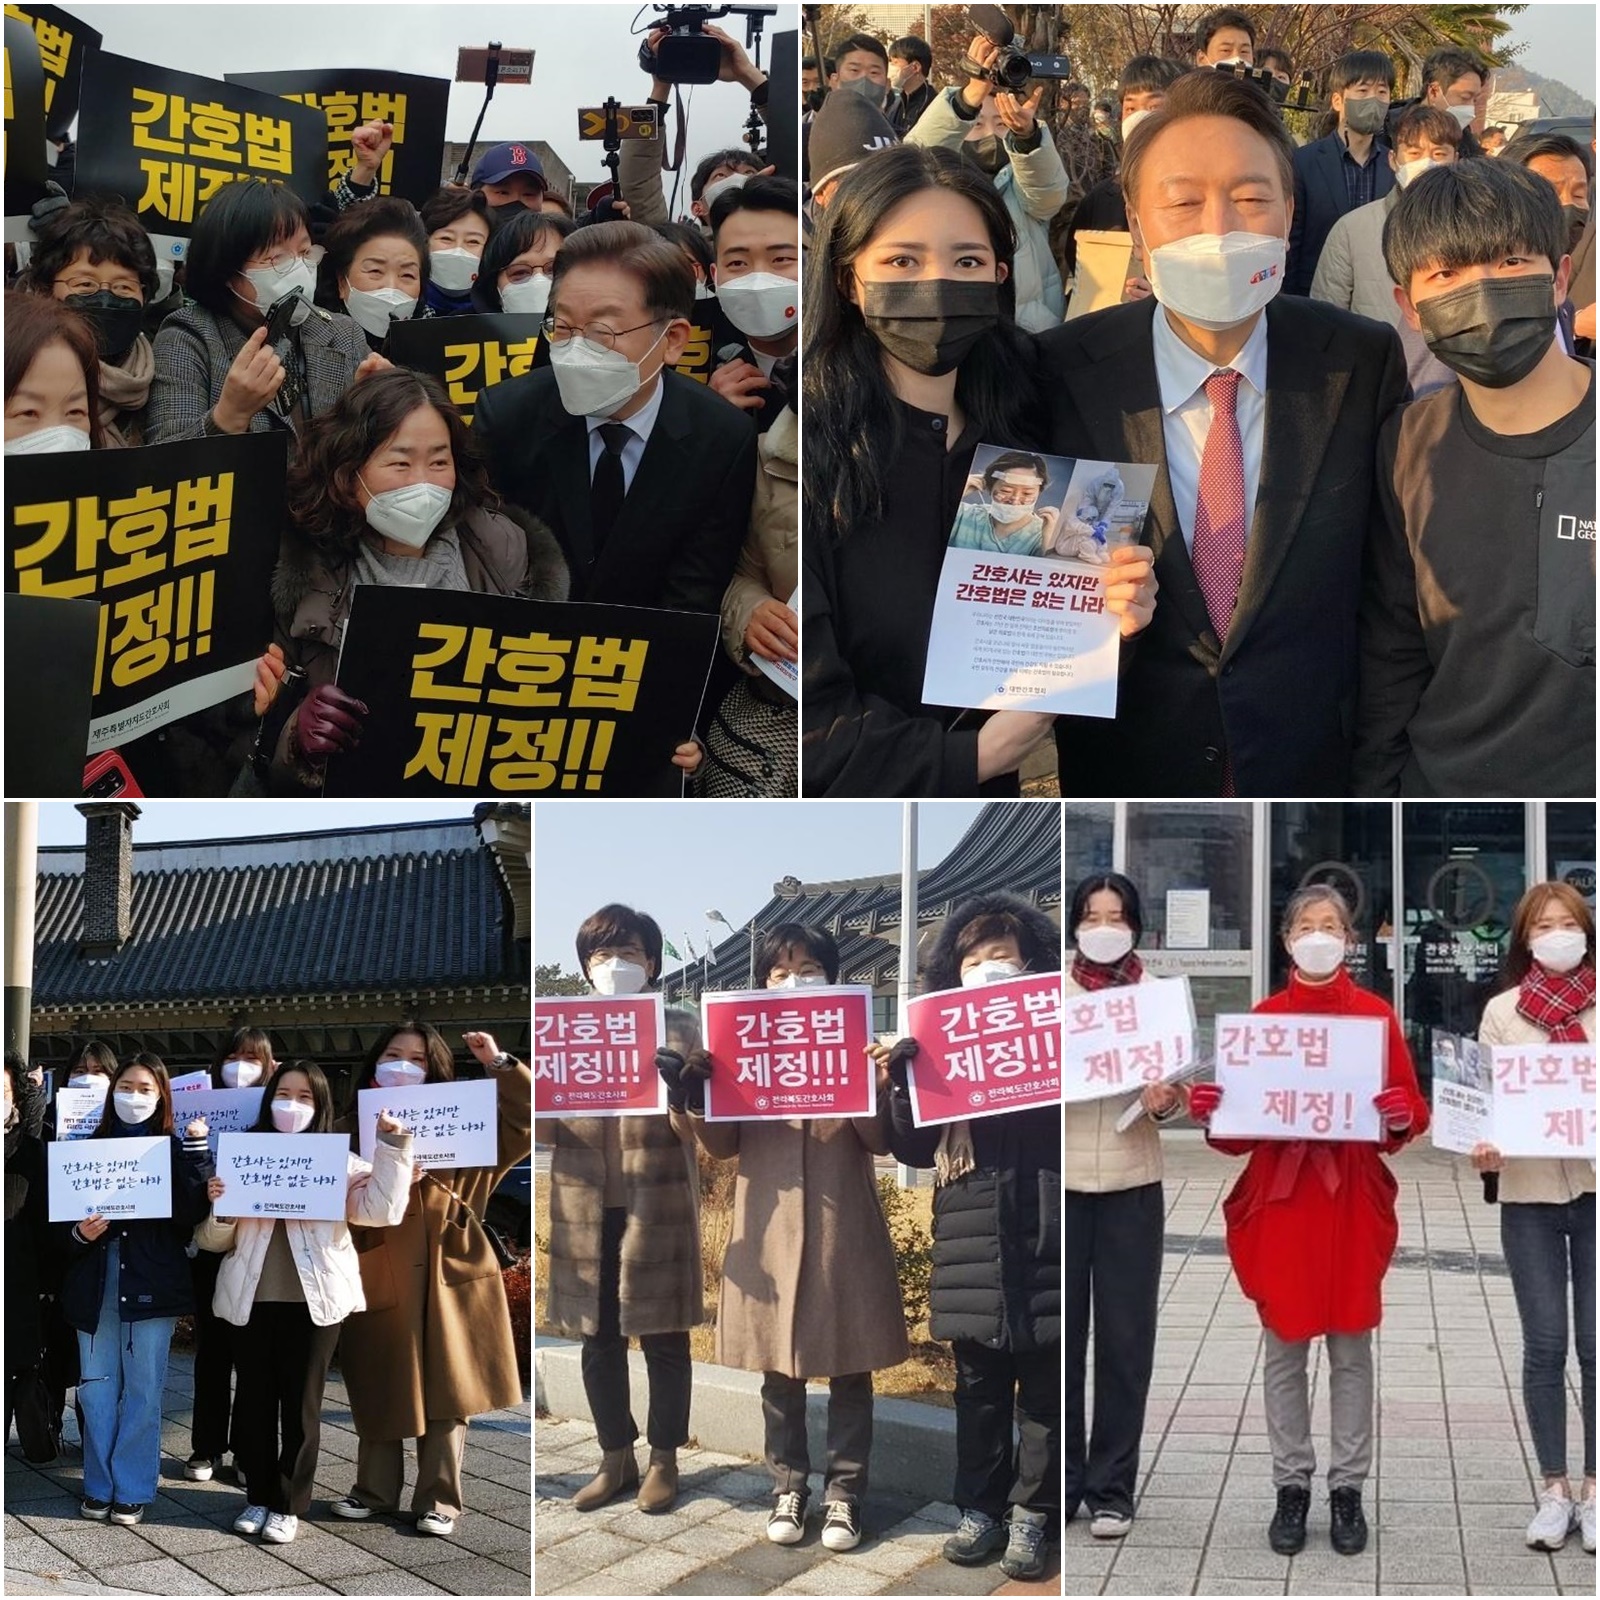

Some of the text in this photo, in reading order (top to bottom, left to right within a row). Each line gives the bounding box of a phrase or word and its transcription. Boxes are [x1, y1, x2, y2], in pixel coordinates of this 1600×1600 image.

[131, 87, 292, 174] 간호법
[509, 146, 527, 165] B
[14, 472, 234, 596] 간호법
[971, 564, 1099, 592] 간호사는 있지만
[956, 583, 1105, 615] 간호법은 없는 나라
[93, 570, 215, 696] 정!!
[410, 623, 649, 712] 간호법
[1009, 685, 1047, 695] 대한간호협회
[404, 712, 616, 791] 제정!!
[535, 1011, 637, 1048] 간호법
[736, 1007, 845, 1049] 간호법
[940, 987, 1061, 1044] 간호법
[1068, 995, 1139, 1035] 호법
[945, 1029, 1061, 1083] 제정!!
[1084, 1036, 1183, 1084] 제정!
[1220, 1024, 1328, 1068] 간호법
[535, 1050, 640, 1085] 제정!!!
[736, 1049, 849, 1089] 제정!!!
[568, 1090, 628, 1100] 전라북도간호사회
[772, 1093, 834, 1104] 전라북도간호사회
[988, 1077, 1060, 1098] 전라북도간호사회
[210, 1109, 239, 1121] 있지만
[424, 1105, 460, 1120] 있지만
[1263, 1089, 1353, 1133] 제정!
[1545, 1108, 1596, 1146] 제
[434, 1124, 458, 1138] 없는
[462, 1121, 486, 1131] 나라
[62, 1159, 140, 1175] 간호사는 있지만
[231, 1155, 313, 1171] 간호사는 있지만
[239, 1172, 337, 1188] 간호법은 없는 나라
[71, 1175, 162, 1191] 간호법은 없는 나라
